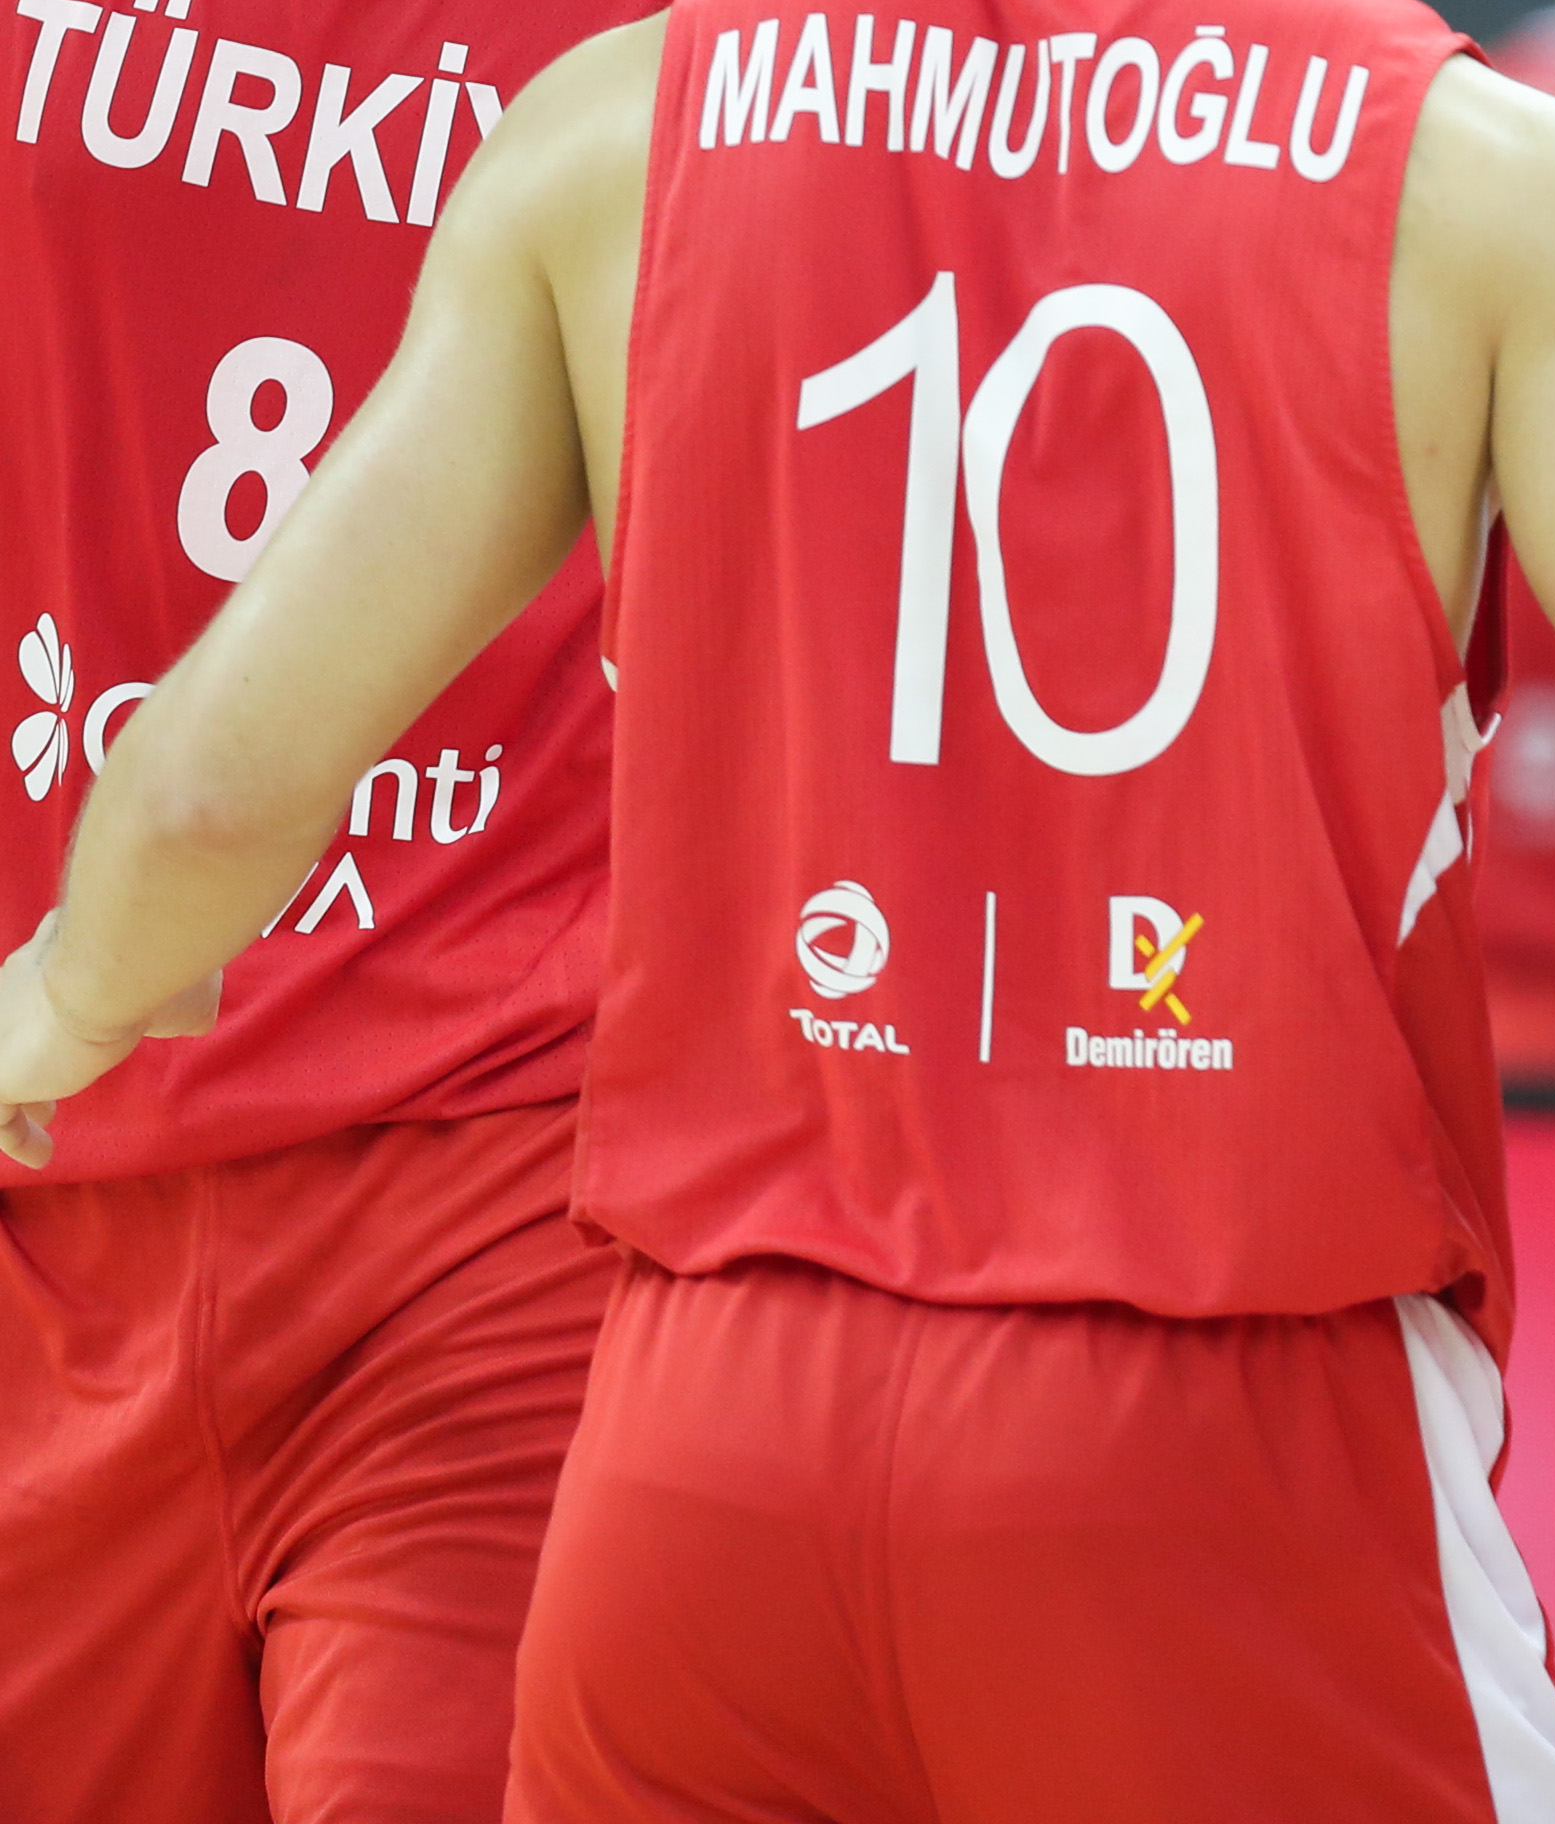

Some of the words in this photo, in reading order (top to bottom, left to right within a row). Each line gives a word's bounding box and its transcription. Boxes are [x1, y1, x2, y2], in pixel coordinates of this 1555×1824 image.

[698, 12, 1370, 183] MAHMUTOĞLU
[176, 335, 335, 583] 8
[796, 270, 1220, 777] 10
[789, 1008, 911, 1055] TOTAL
[1065, 1026, 1234, 1071] Demirören
